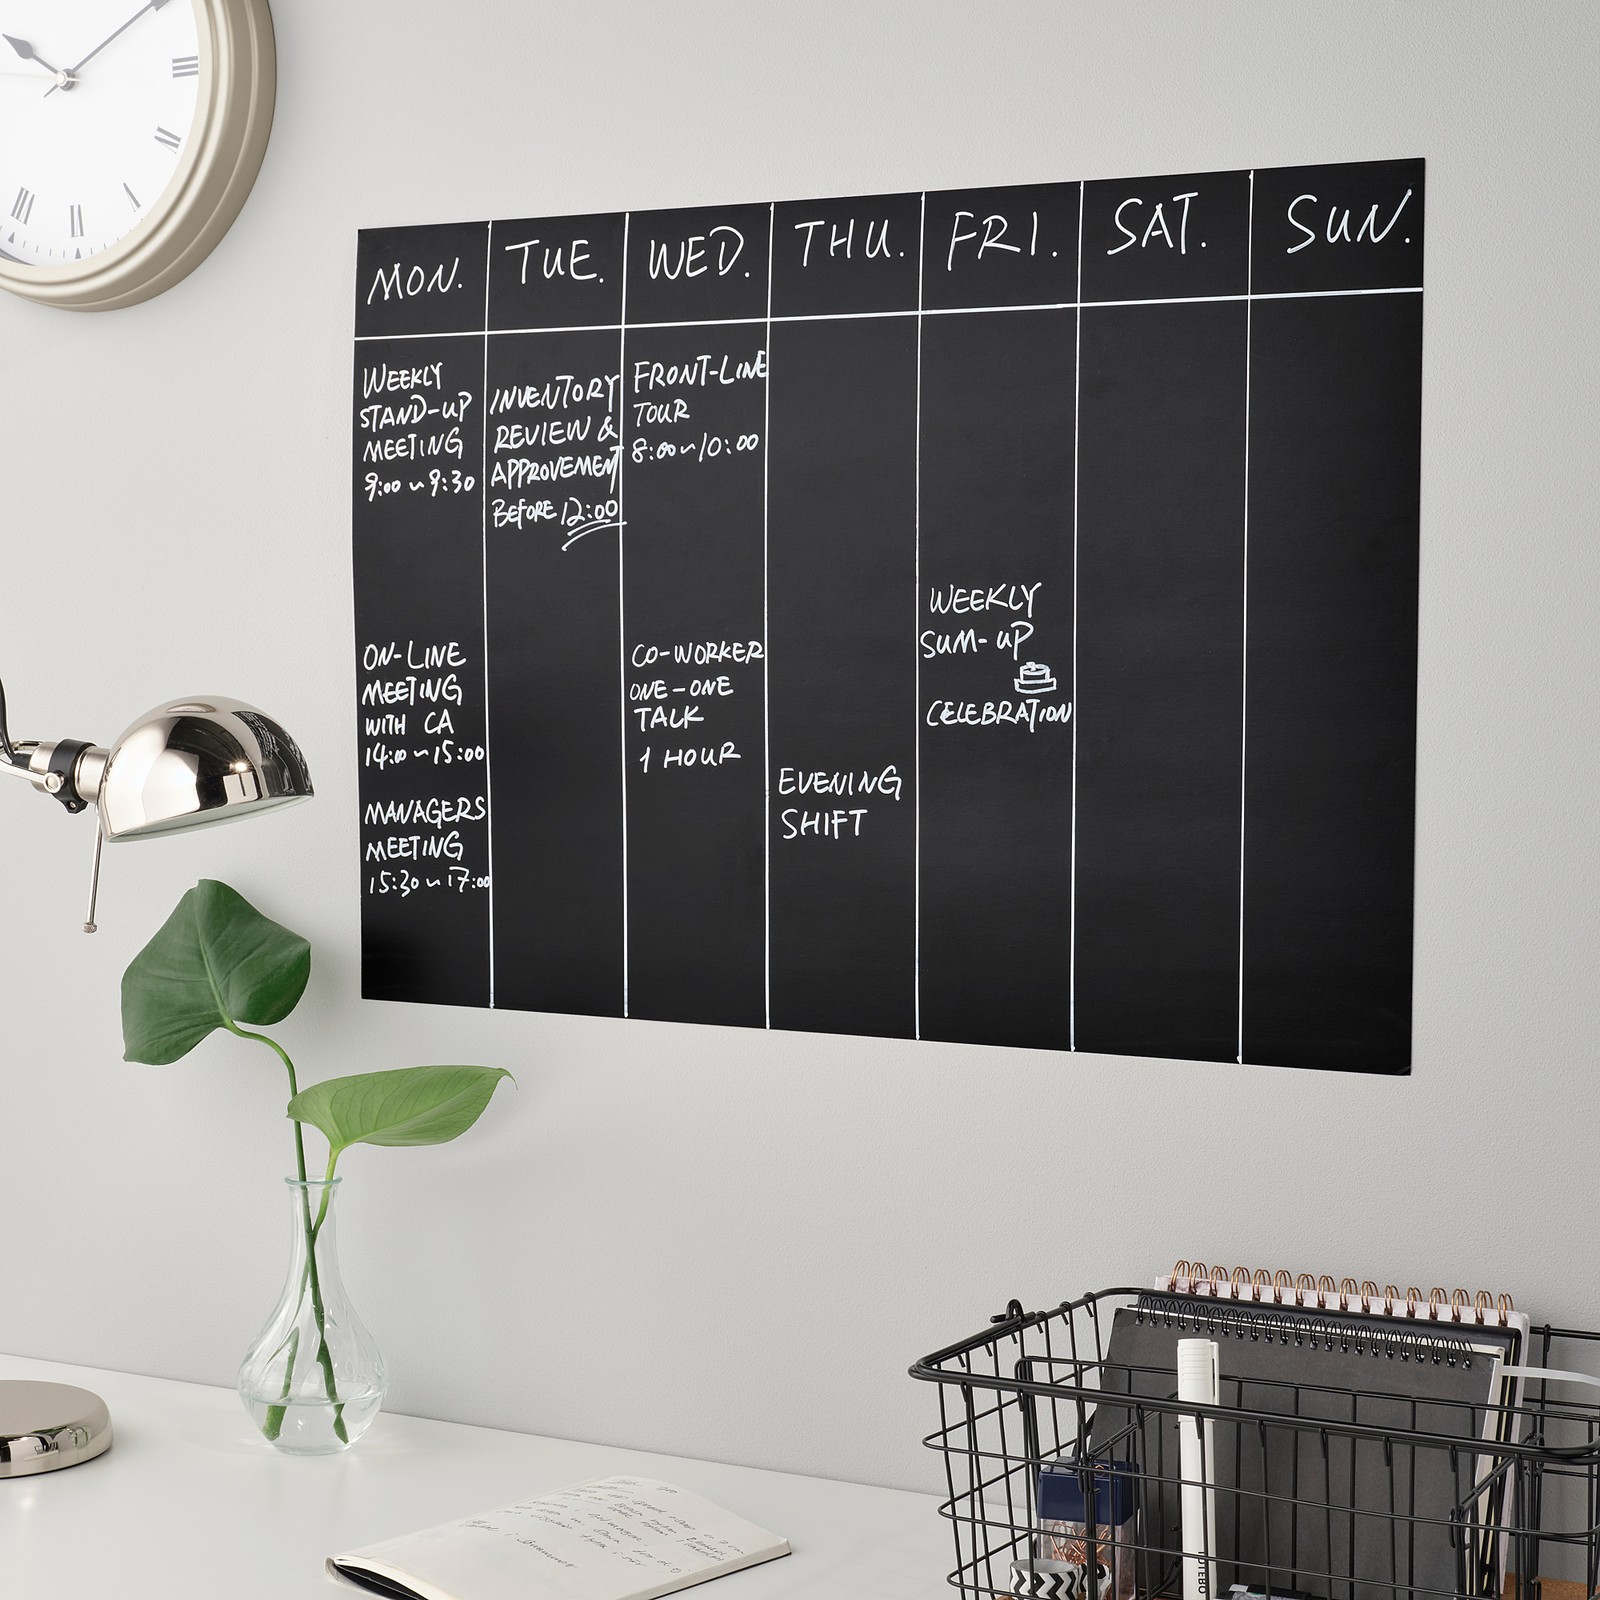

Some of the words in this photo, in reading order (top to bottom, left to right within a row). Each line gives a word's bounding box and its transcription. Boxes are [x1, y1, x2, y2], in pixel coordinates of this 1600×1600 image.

[1106, 191, 1208, 256] SAT.
[1286, 188, 1413, 255] SUN.
[648, 225, 750, 280] WED.
[794, 218, 905, 268] THU.
[947, 211, 1058, 272] FRI.
[504, 239, 604, 285] TUE.
[366, 256, 463, 306] MON.
[363, 361, 444, 400] WEEKLY
[634, 349, 770, 394] FRONT-LINE
[360, 391, 474, 433] STAND-UP
[489, 374, 622, 416] INVENTORY
[632, 398, 691, 428] TOUR
[362, 427, 464, 463] MEETING
[493, 415, 592, 455] REVIEW
[597, 415, 619, 443] &
[491, 498, 559, 531] BEFORE
[560, 496, 619, 527] 12:00
[929, 581, 1043, 619] WEEKLY
[362, 639, 468, 671] ON-LINE
[631, 640, 766, 669] CO-WORKER
[361, 673, 464, 707] MEETING
[365, 713, 407, 737] WITH
[423, 708, 455, 735] CA
[634, 705, 706, 734] TALK
[926, 698, 1073, 734] CELEBRATION
[639, 746, 652, 774] 1
[663, 741, 743, 769] HOUR
[778, 764, 903, 801] EVENING
[364, 795, 488, 830] MANAGERS
[781, 808, 869, 840] SHIFT
[366, 830, 464, 863] MEETING
